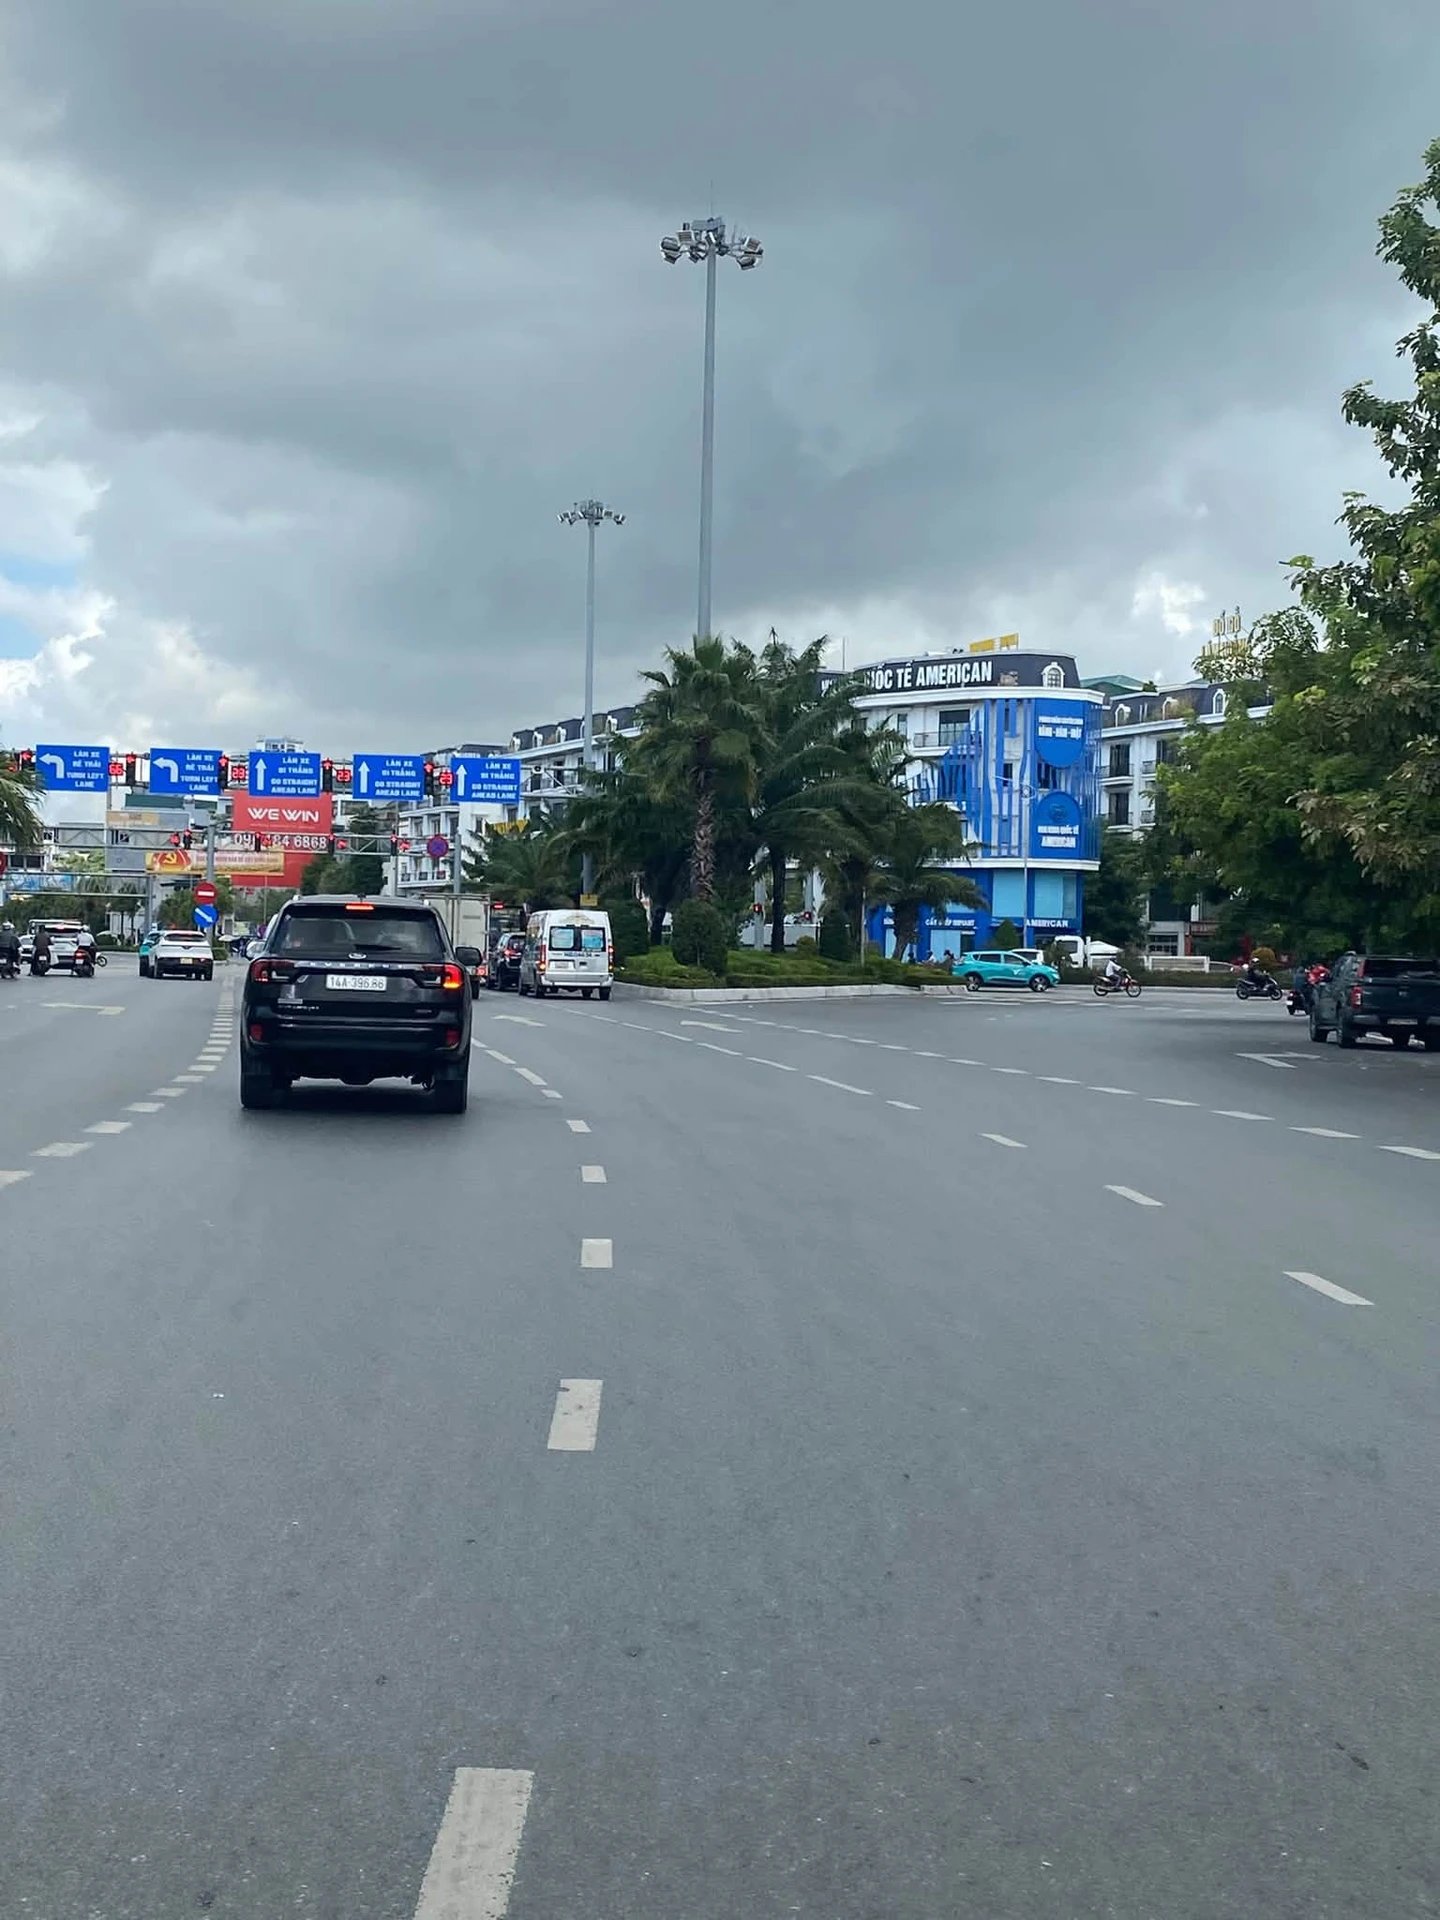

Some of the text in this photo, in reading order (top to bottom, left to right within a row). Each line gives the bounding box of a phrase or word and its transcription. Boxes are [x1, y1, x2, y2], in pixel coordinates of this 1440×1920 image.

[916, 661, 993, 687] AMERICAN
[74, 750, 88, 758] LÀN
[386, 759, 401, 767] LÀN
[485, 762, 501, 770] LÀN
[75, 780, 95, 788] LANE
[401, 789, 420, 797] LANE
[247, 807, 319, 823] WE WIN
[294, 836, 327, 848] 6868
[1026, 919, 1069, 928] AMERICAN
